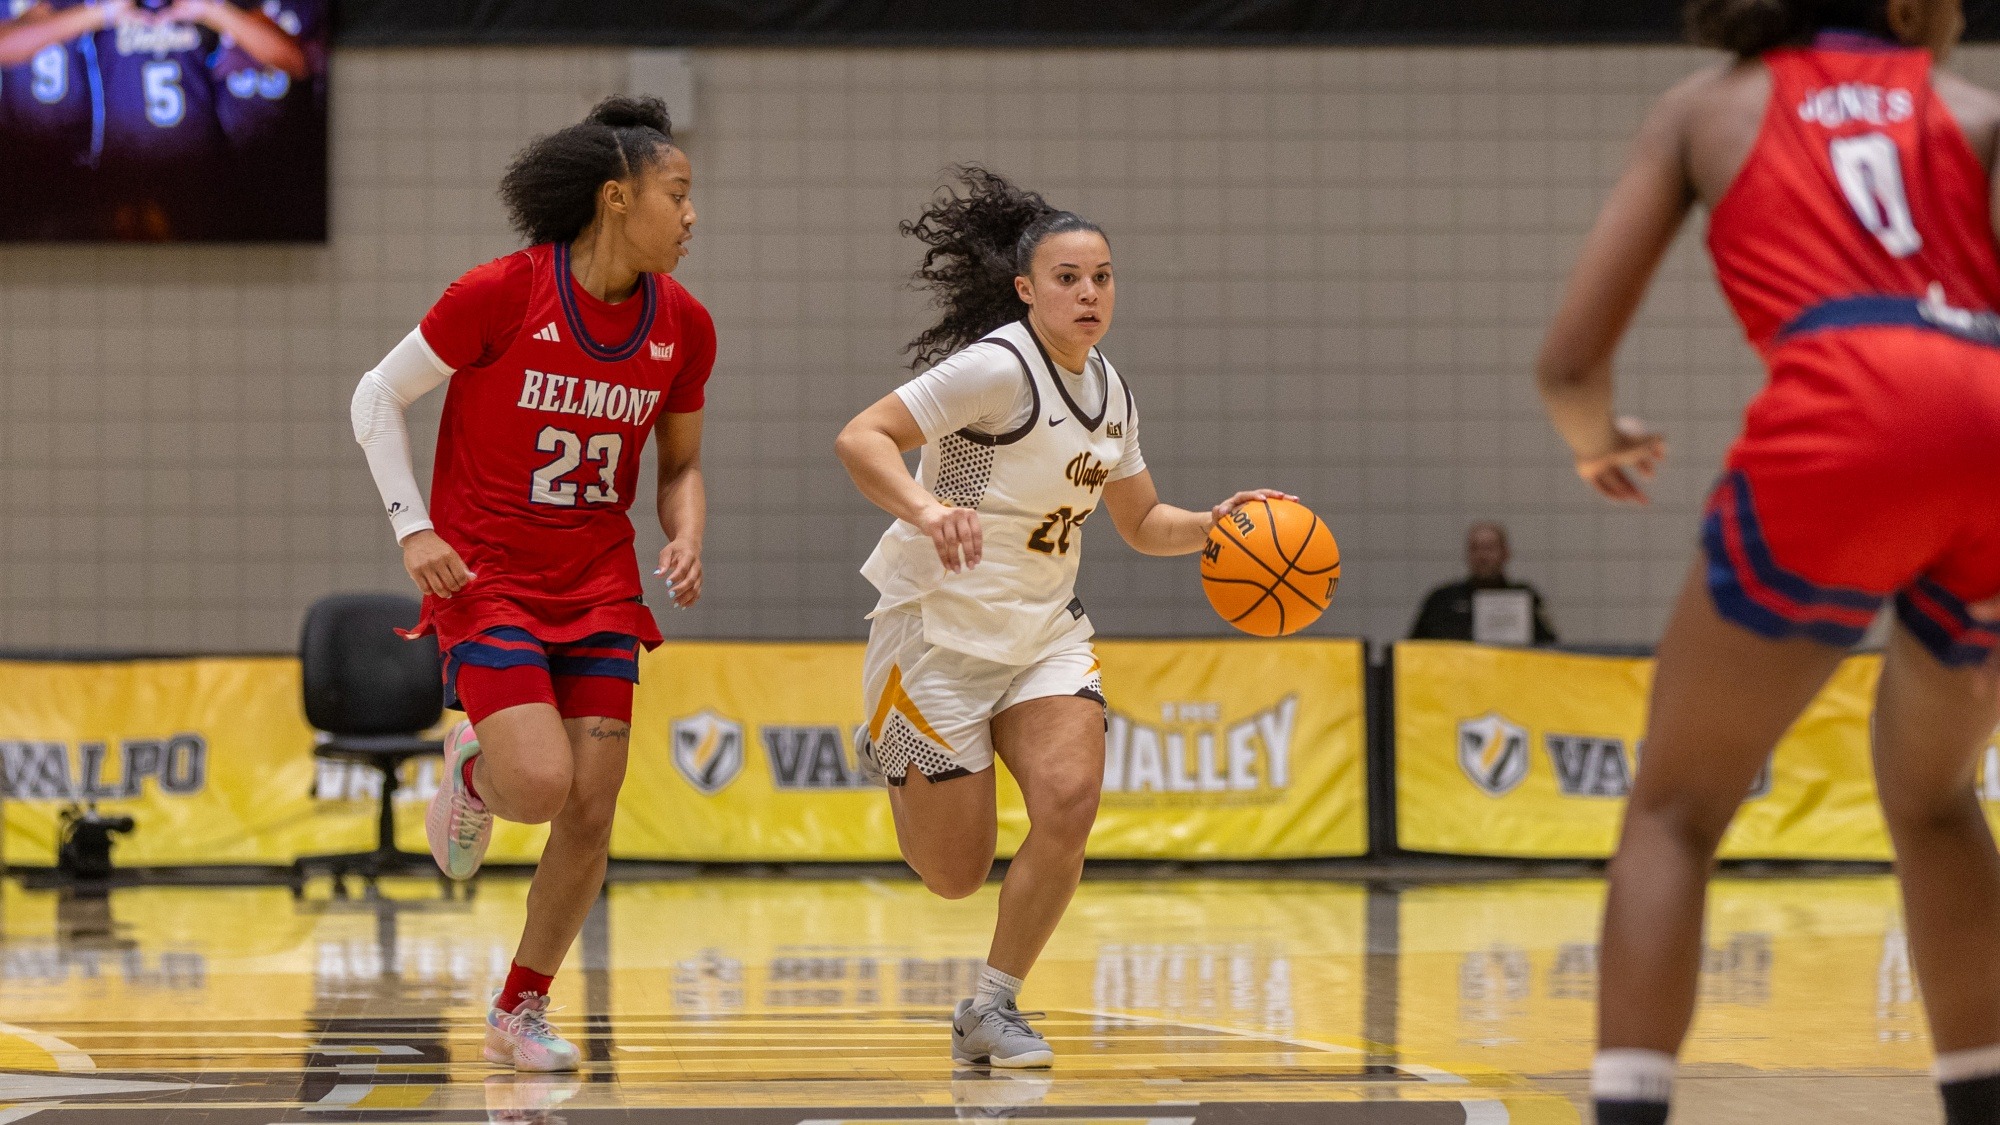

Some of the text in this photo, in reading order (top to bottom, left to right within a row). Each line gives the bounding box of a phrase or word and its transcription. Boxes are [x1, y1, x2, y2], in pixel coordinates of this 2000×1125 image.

[31, 44, 69, 104] 9
[142, 60, 186, 128] 5
[1798, 82, 1914, 128] JONES
[1829, 131, 1924, 259] 0
[517, 368, 662, 427] BELMONT
[529, 424, 623, 507] 23
[0, 733, 207, 800] VALPO
